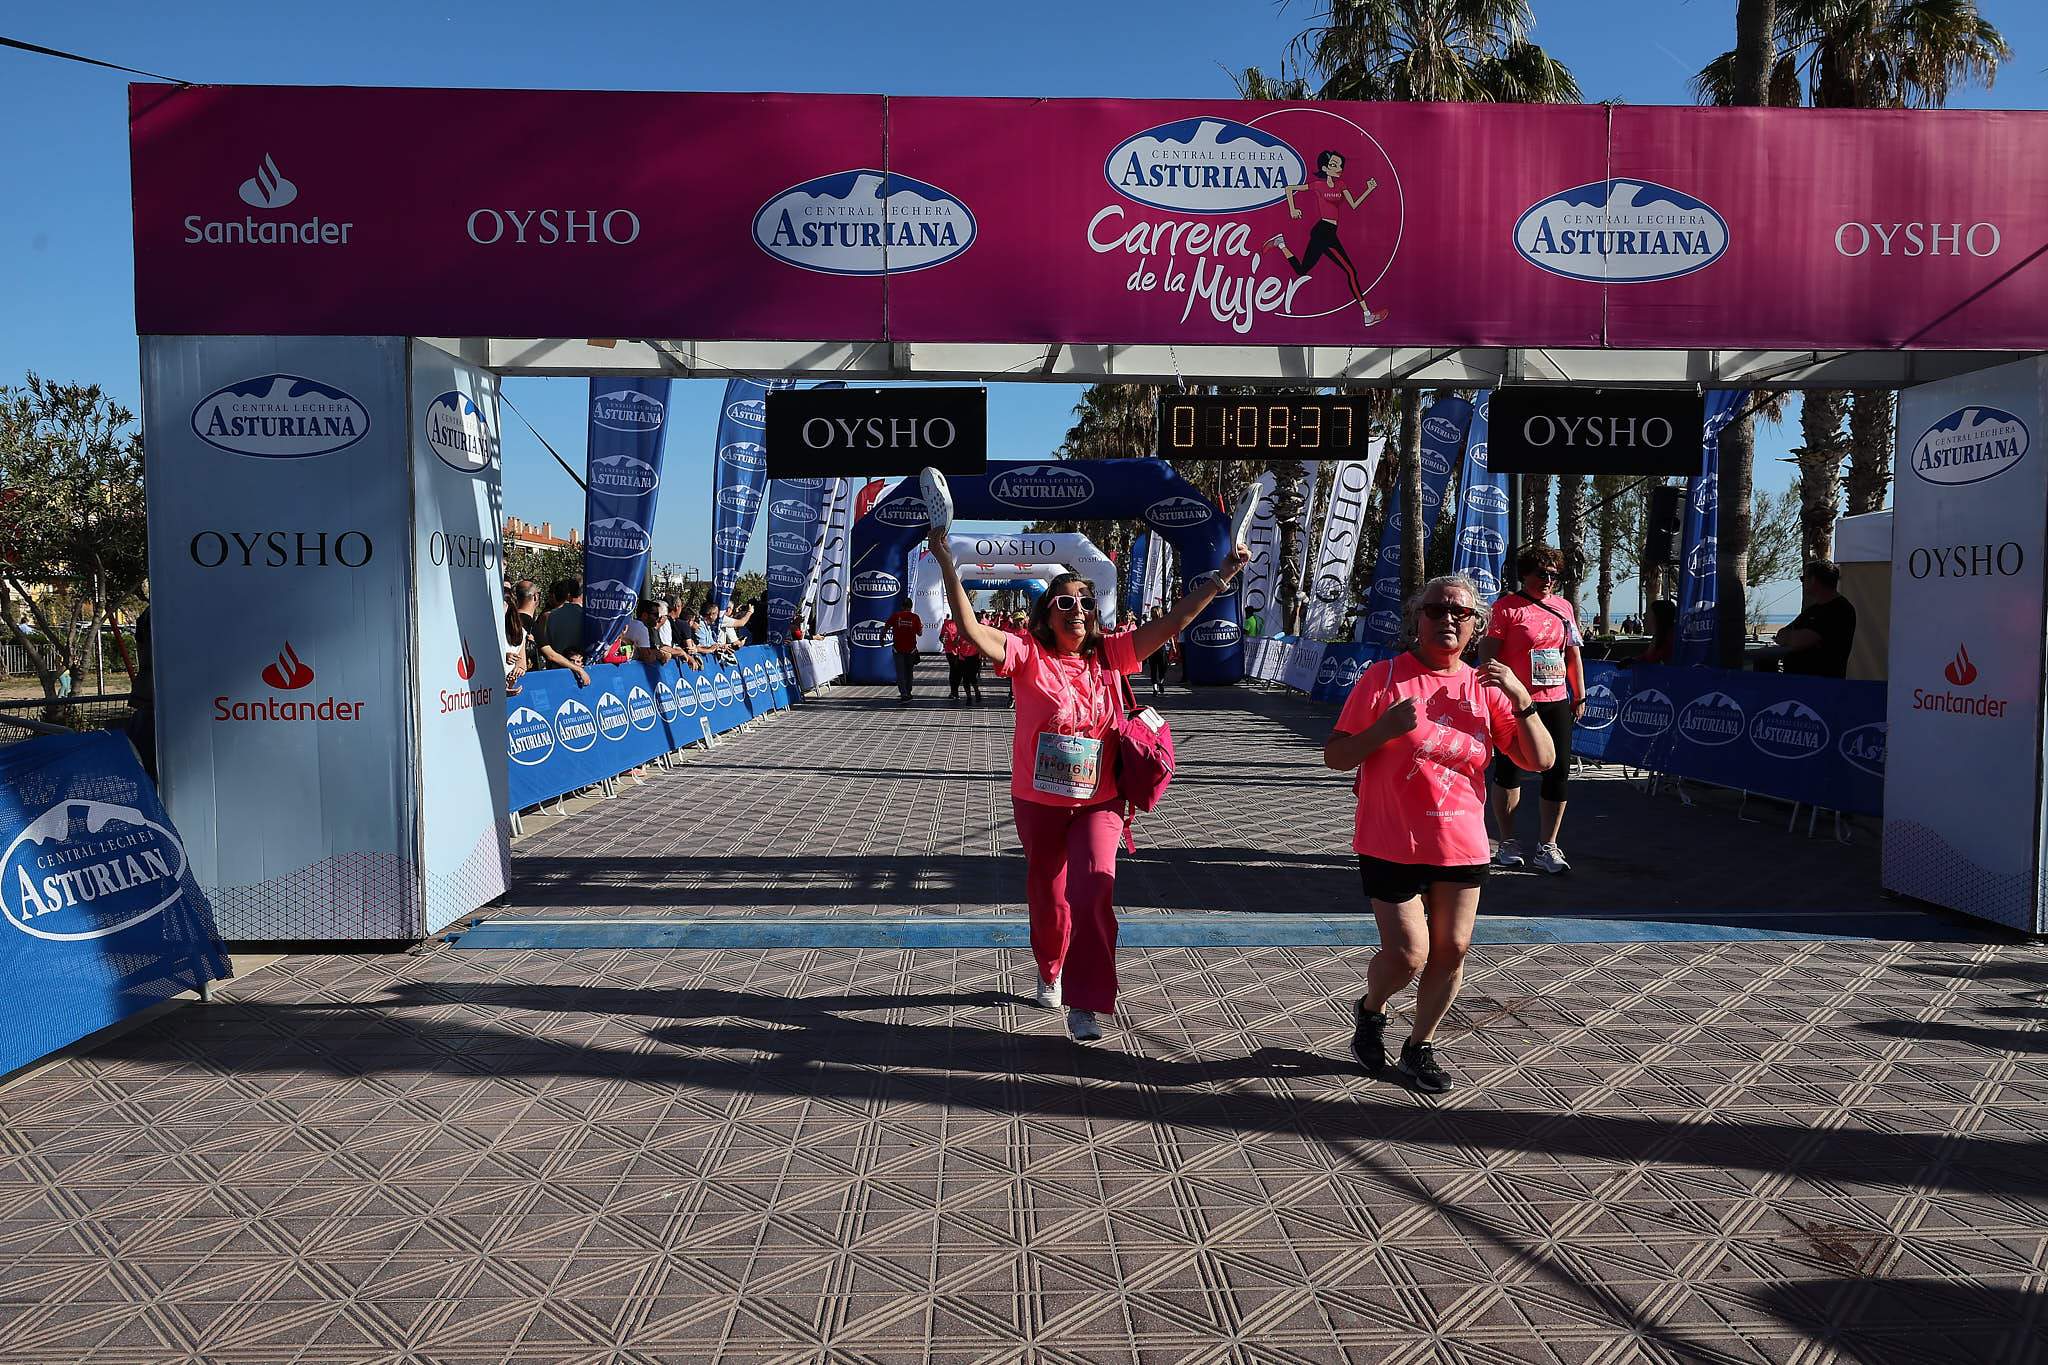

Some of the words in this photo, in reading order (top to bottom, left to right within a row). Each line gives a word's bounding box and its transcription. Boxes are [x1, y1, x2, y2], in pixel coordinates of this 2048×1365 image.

[1120, 151, 1289, 188] ASTURIANA
[1152, 150, 1217, 160] CENTRAL
[1220, 150, 1284, 161] LECHERA
[804, 206, 874, 216] CENTRAL
[1563, 214, 1631, 225] CENTRAL
[1637, 214, 1706, 225] LECHERA
[184, 215, 353, 245] Santander
[466, 208, 641, 245] OYSHO
[769, 208, 960, 248] ASTURIANA
[1087, 205, 1252, 257] Carrera
[1529, 215, 1712, 256] ASTURIANA
[1834, 222, 2001, 257] OYSHO
[1127, 258, 1157, 292] de
[1164, 257, 1185, 293] la
[1180, 253, 1313, 334] Mujer
[205, 405, 357, 437] ASTURIANA
[232, 403, 289, 412] CENTRAL
[293, 403, 351, 412] LECHERA
[593, 402, 661, 424] ASTURIANA
[731, 406, 767, 423] ASTURI
[431, 411, 490, 458] ASTURIANA
[802, 417, 956, 449] OYSHO
[1173, 406, 1353, 448] 01:08:37
[1523, 415, 1673, 448] OYSHO
[1935, 433, 1973, 446] CENTRAL
[1974, 426, 2016, 440] LECHERA
[724, 448, 768, 466] ASTURIA
[1918, 437, 2020, 471] ASTURIANA
[720, 493, 760, 509] ASTURIAN
[996, 479, 1088, 498] ASTURIANA
[878, 506, 929, 521] ASTURIAN
[1151, 507, 1208, 521] ASTURIANA
[589, 536, 645, 551] STURIANA
[820, 478, 849, 605] OYSHO
[975, 539, 1056, 556] OYSHO
[1316, 463, 1369, 603] OYSHO
[190, 531, 374, 568] OYSHO
[430, 531, 495, 570] OYSHO
[1246, 496, 1276, 613] OYSHO
[1909, 542, 2024, 579] OYSHO
[769, 573, 802, 583] STURIANA
[854, 577, 898, 592] ASTURIANA
[586, 598, 633, 611] STURINA
[214, 696, 365, 721] Santander
[440, 686, 493, 714] Santander
[1584, 705, 1614, 720] TURIANA
[1912, 688, 2008, 719] Santander
[1623, 705, 1668, 726] ASTURIANA
[1681, 709, 1738, 735] ASTURIANA
[508, 732, 553, 755] ASTURIANA
[559, 720, 596, 741] ASTURIANA
[1753, 717, 1819, 748] ASTURIANA
[37, 843, 96, 869] CENTRAL
[100, 831, 155, 853] LECHE
[18, 848, 174, 921] ASTURIAN
